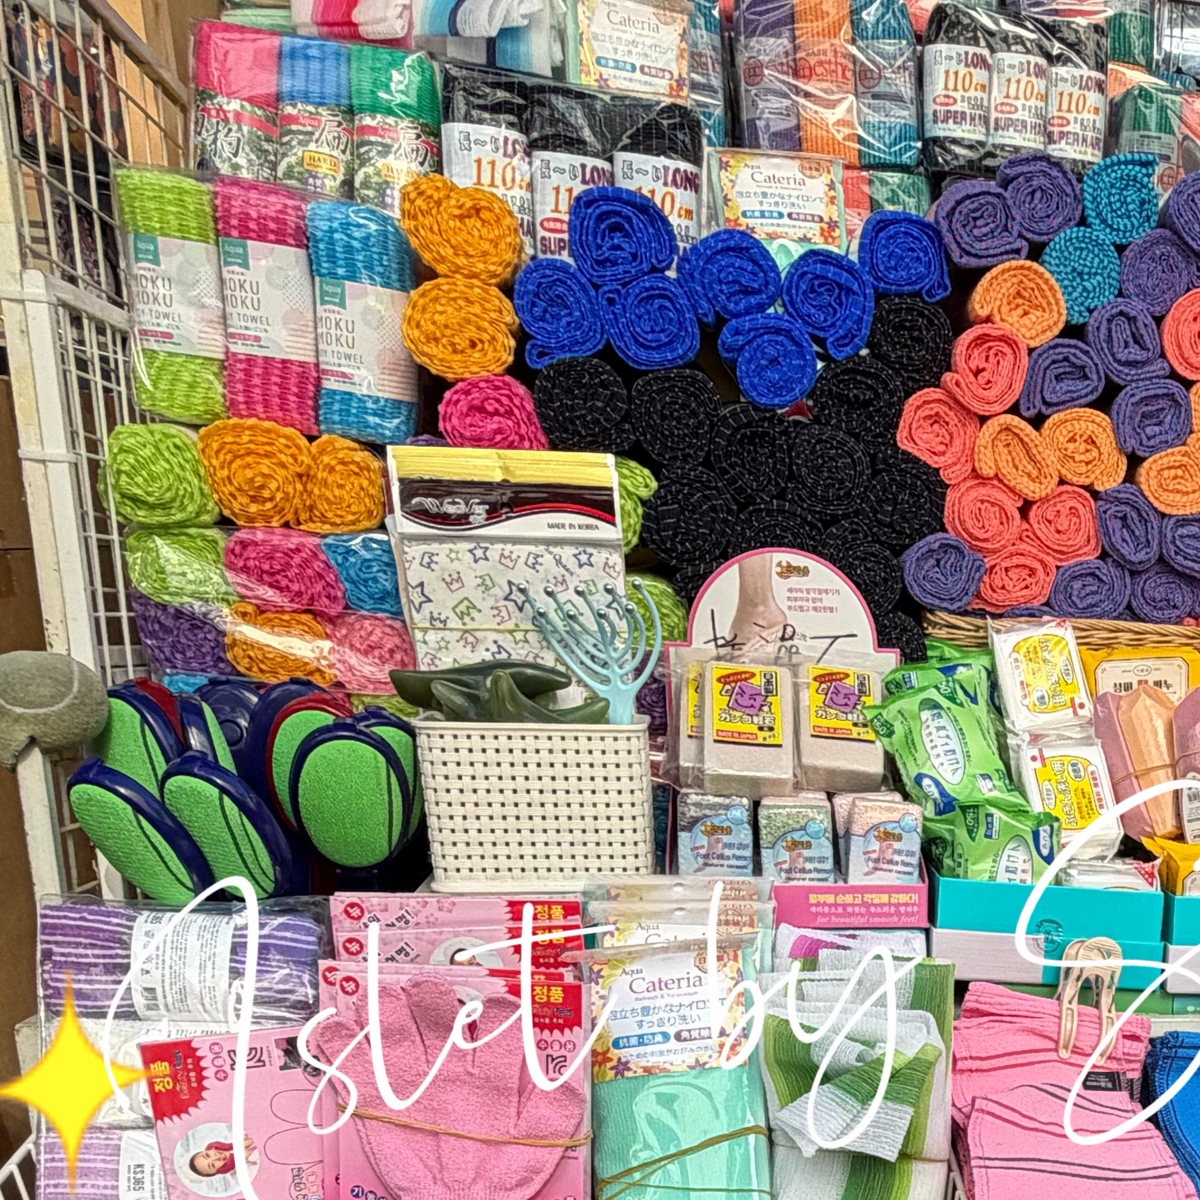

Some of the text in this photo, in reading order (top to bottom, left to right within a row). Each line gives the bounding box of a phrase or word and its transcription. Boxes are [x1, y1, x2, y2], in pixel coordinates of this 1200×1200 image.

[606, 10, 661, 35] Cateria
[1026, 59, 1048, 79] LON
[942, 69, 974, 93] 110
[1003, 77, 1035, 101] 110
[1056, 91, 1086, 115] 110
[932, 109, 968, 126] SUPER
[994, 116, 1028, 133] SUPER
[473, 156, 516, 190] 110
[580, 162, 613, 187] LON
[662, 164, 700, 194] LONG
[751, 171, 806, 187] Cateria
[677, 204, 694, 222] cm
[540, 235, 569, 256] SUP
[150, 309, 184, 324] TOWEL
[236, 312, 271, 327] TOWEL
[330, 350, 365, 365] TOWEL
[547, 522, 600, 532] MADE IN KOREA
[718, 711, 776, 726] ガンコ軽石
[1051, 759, 1079, 827] ふきん洗い用
[534, 904, 565, 921] 정품
[831, 915, 868, 924] beautiful
[868, 915, 899, 924] smooth
[635, 922, 660, 932] Aqua
[619, 967, 643, 977] Aqua
[628, 971, 703, 994] Cateria
[533, 986, 565, 1003] 정품
[609, 997, 727, 1021] 泡立ち豊かなナイロで
[635, 1014, 701, 1030] すっきり洗い
[618, 1032, 666, 1047] 抗菌・防臭
[680, 1028, 712, 1041] 角質除
[132, 1163, 146, 1192] KS365
